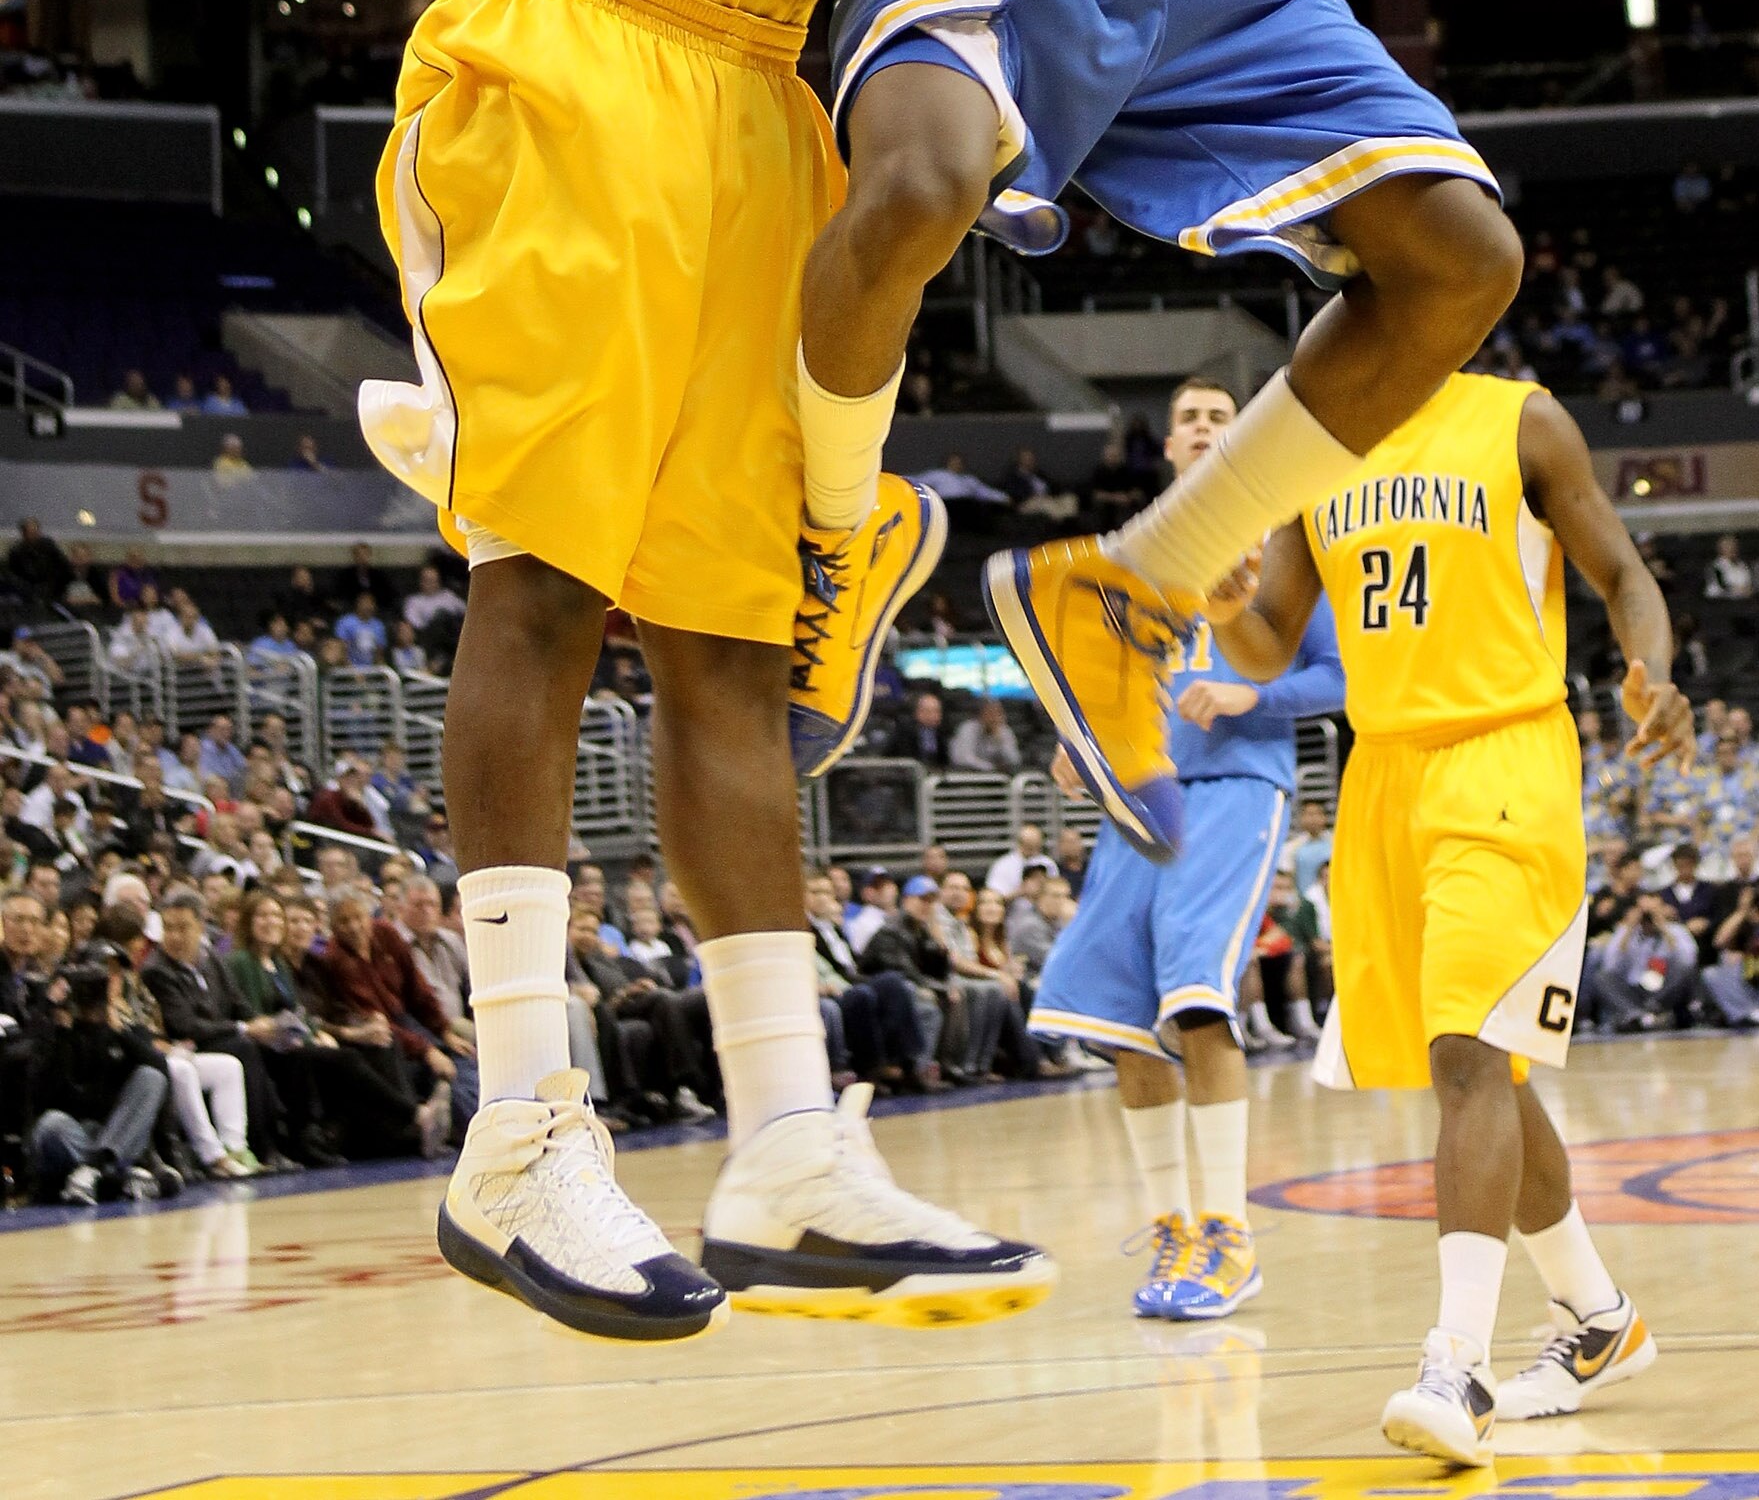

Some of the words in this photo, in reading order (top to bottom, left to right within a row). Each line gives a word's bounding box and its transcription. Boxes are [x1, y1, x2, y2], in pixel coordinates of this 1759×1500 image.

[138, 472, 169, 529] S
[1313, 474, 1491, 552] CALIFORNIA
[1361, 543, 1430, 630] 24
[1538, 984, 1573, 1033] C
